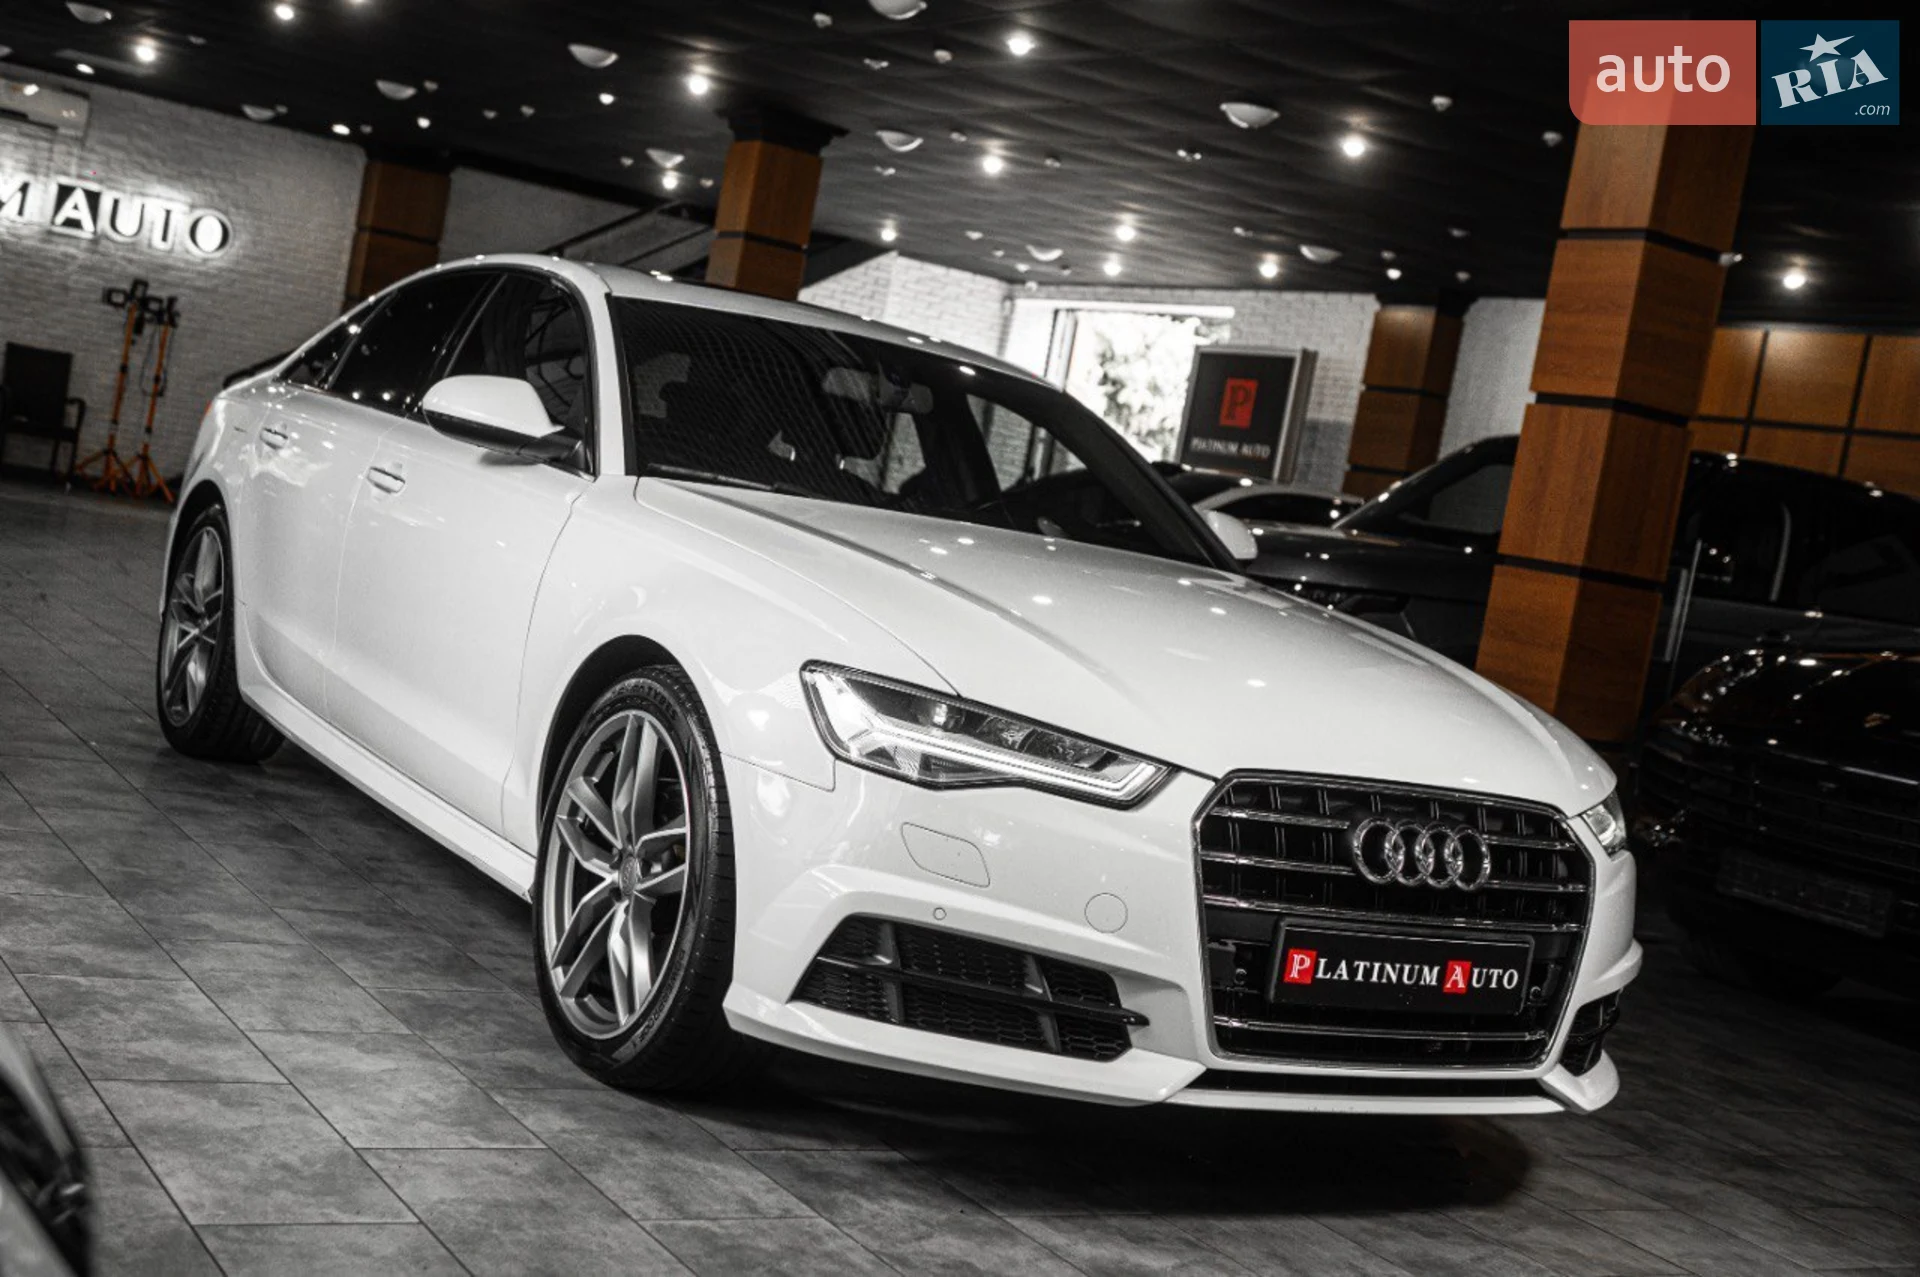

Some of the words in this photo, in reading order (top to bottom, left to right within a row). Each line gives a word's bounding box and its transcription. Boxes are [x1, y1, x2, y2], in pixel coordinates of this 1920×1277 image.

[52, 183, 230, 252] AUTO
[1288, 953, 1440, 987] PLATINUM
[1445, 965, 1519, 990] AUTO
